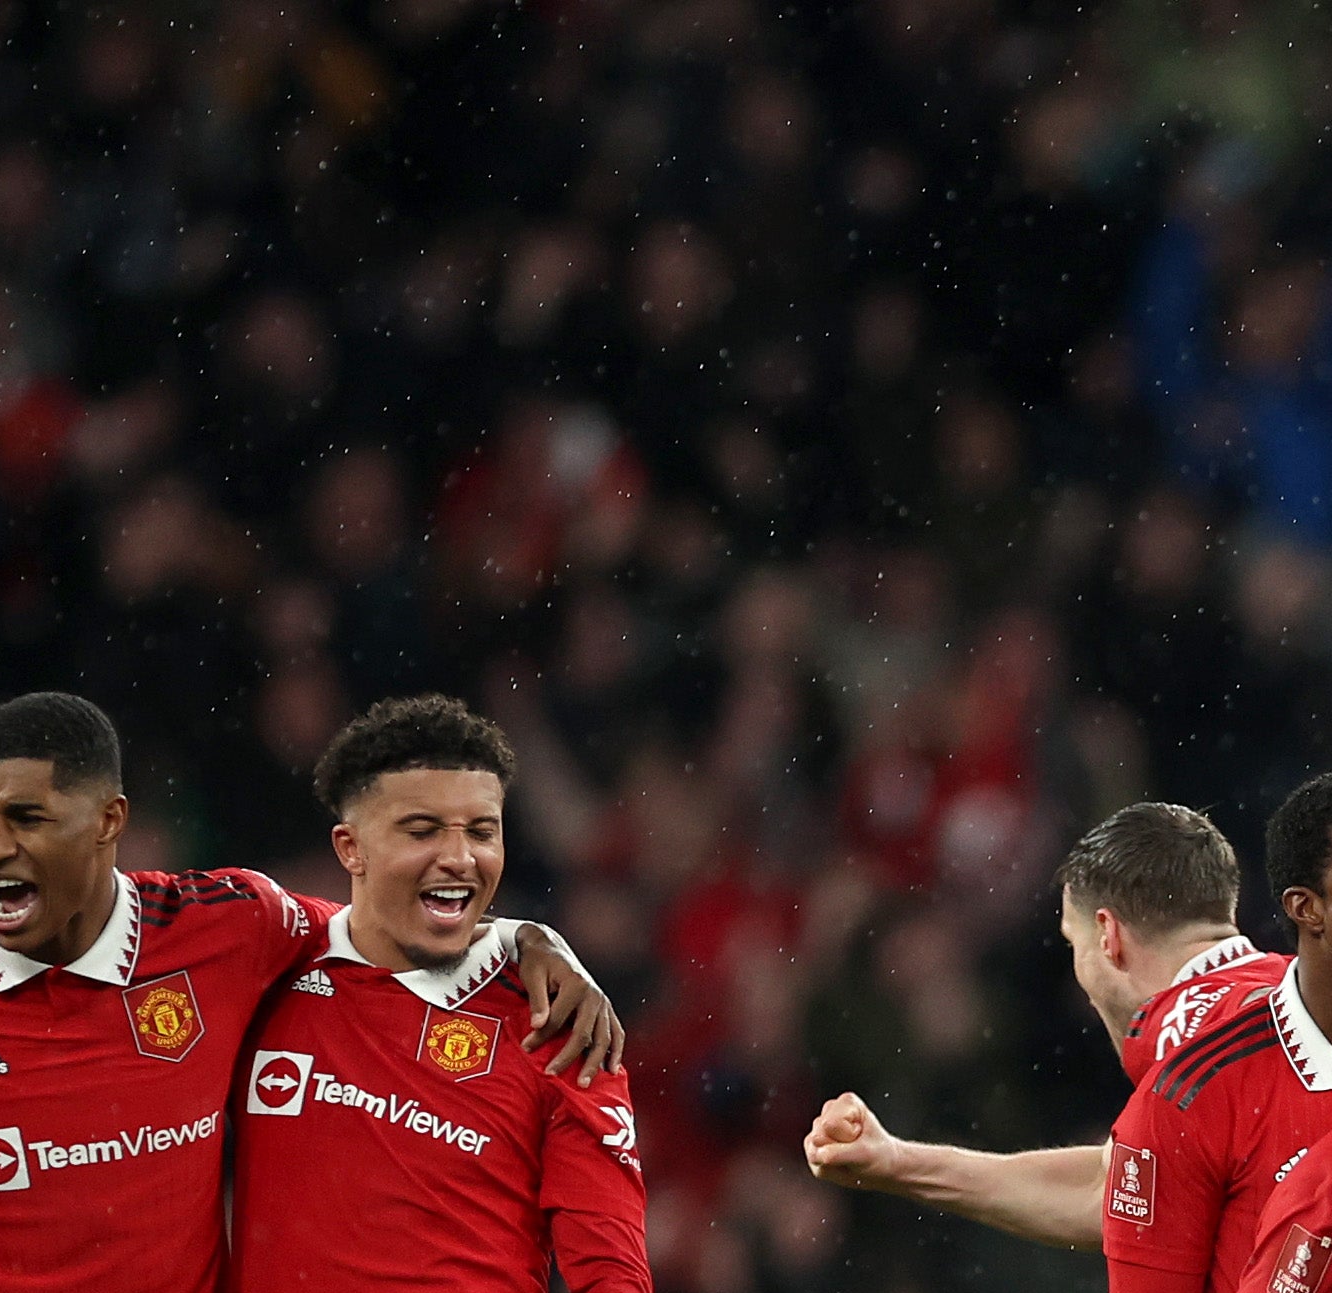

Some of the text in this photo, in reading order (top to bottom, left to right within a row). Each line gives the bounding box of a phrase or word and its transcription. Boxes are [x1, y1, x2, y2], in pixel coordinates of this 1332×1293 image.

[292, 980, 335, 997] adidas
[311, 1072, 491, 1156] TeamViewer
[27, 1110, 219, 1171] TeamViewer
[1113, 1188, 1148, 1207] Emirates
[1112, 1199, 1148, 1218] FA CUP
[1272, 1278, 1284, 1293] FA
